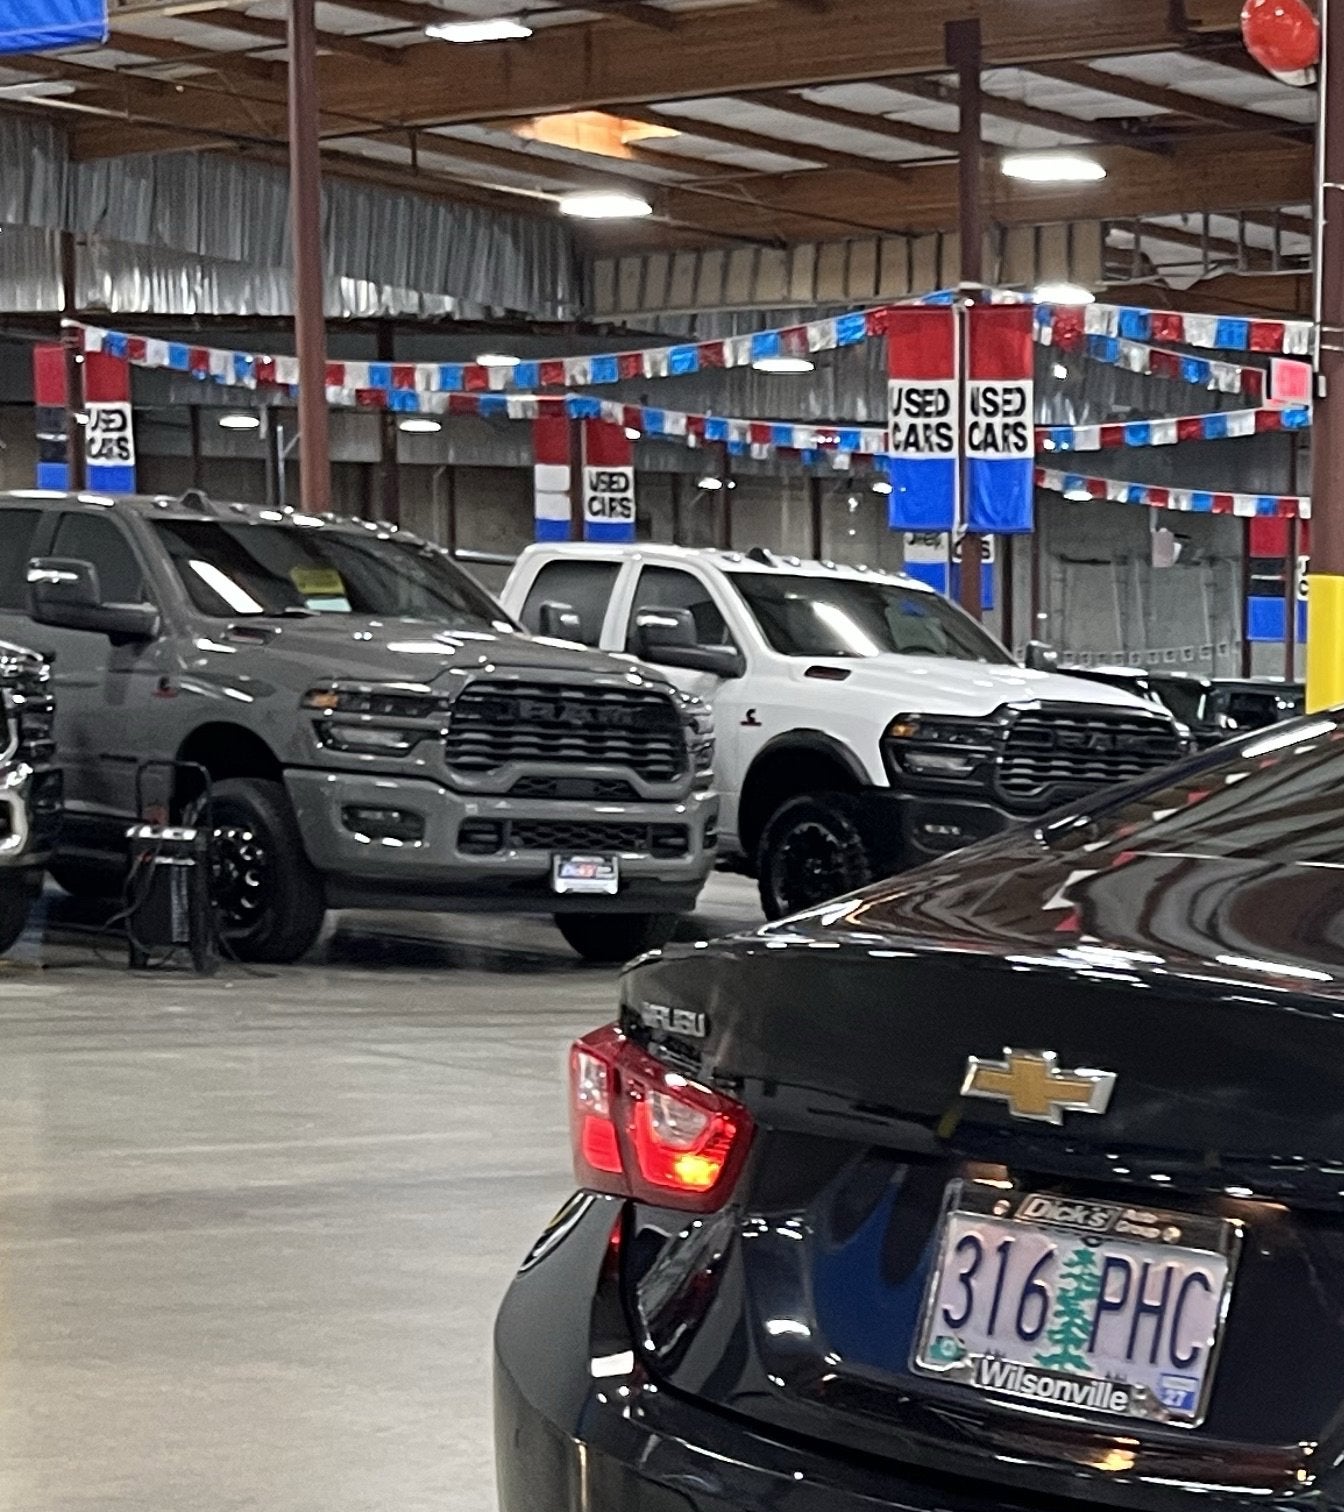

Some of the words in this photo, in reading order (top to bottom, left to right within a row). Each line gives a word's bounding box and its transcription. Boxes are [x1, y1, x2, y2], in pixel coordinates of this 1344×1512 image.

[890, 387, 950, 418] USED
[971, 387, 1027, 418] USED
[892, 421, 954, 452] CARS
[968, 421, 1029, 452] CARS
[588, 471, 630, 493] USED
[1023, 1197, 1110, 1229] Dick's
[941, 1234, 1057, 1342] 316
[1087, 1254, 1212, 1369] PHC
[979, 1357, 1129, 1412] Wilsonville
